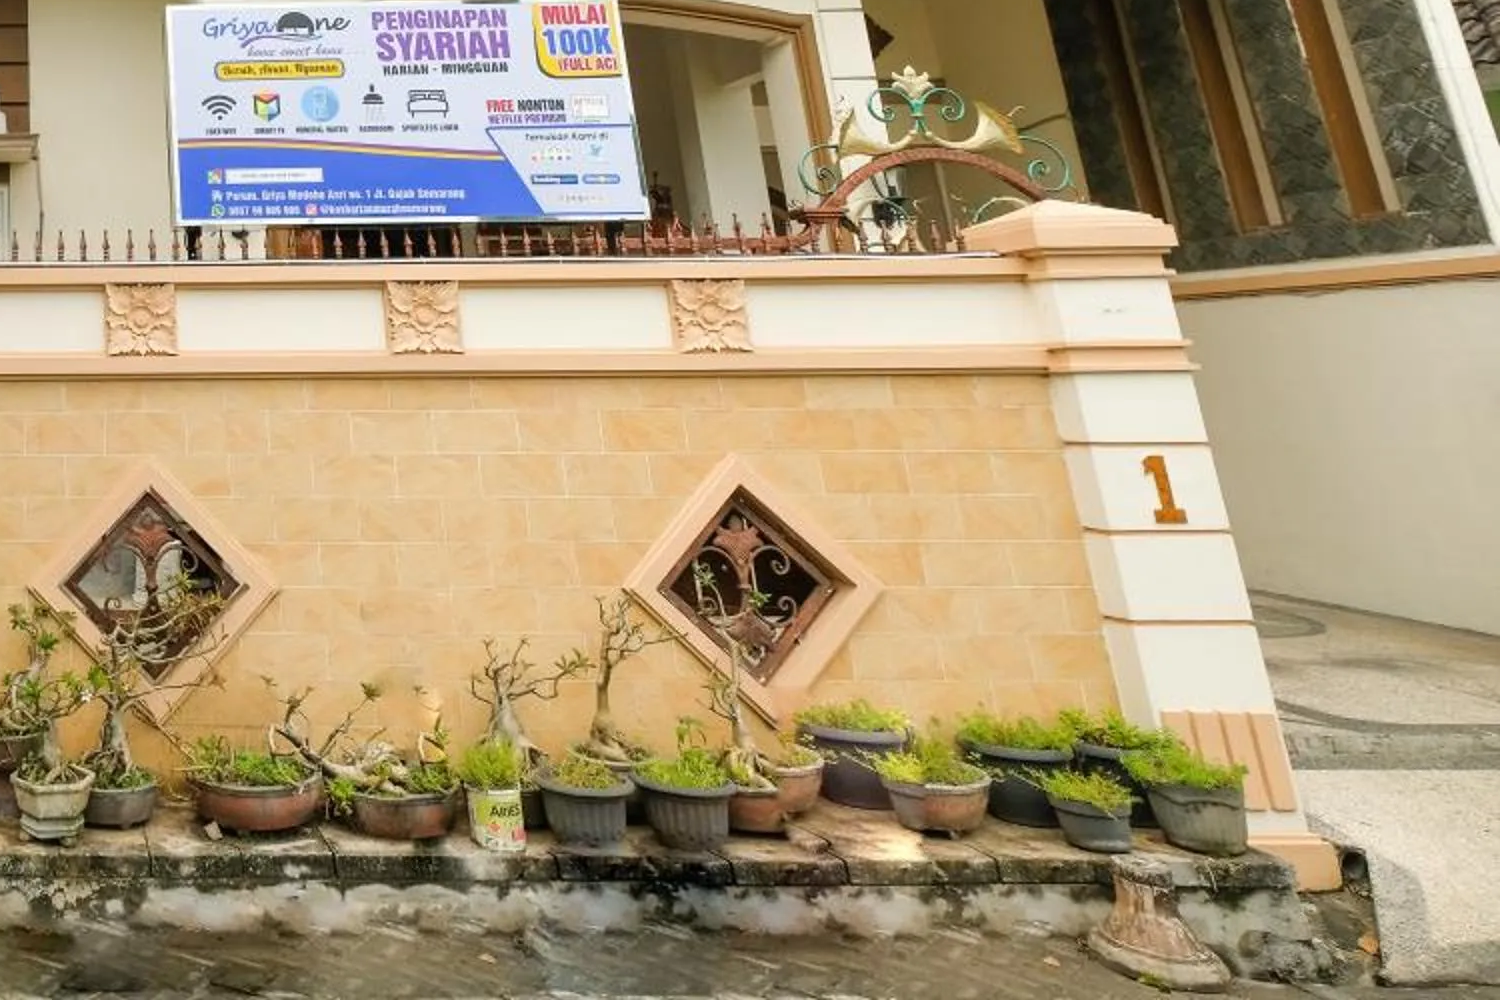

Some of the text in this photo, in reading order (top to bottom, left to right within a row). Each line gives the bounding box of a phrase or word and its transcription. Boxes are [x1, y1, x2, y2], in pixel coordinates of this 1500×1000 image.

[371, 9, 508, 30] PENGINAPAN
[541, 4, 607, 25] MULAI
[203, 17, 277, 41] Griya
[376, 31, 510, 61] SYARIAH
[542, 28, 613, 56] 100K
[383, 64, 429, 76] HARIAN
[441, 61, 509, 74] MINGGUAN
[486, 99, 514, 113] FREE
[518, 99, 565, 112] NONTON
[1142, 455, 1188, 524] 1
